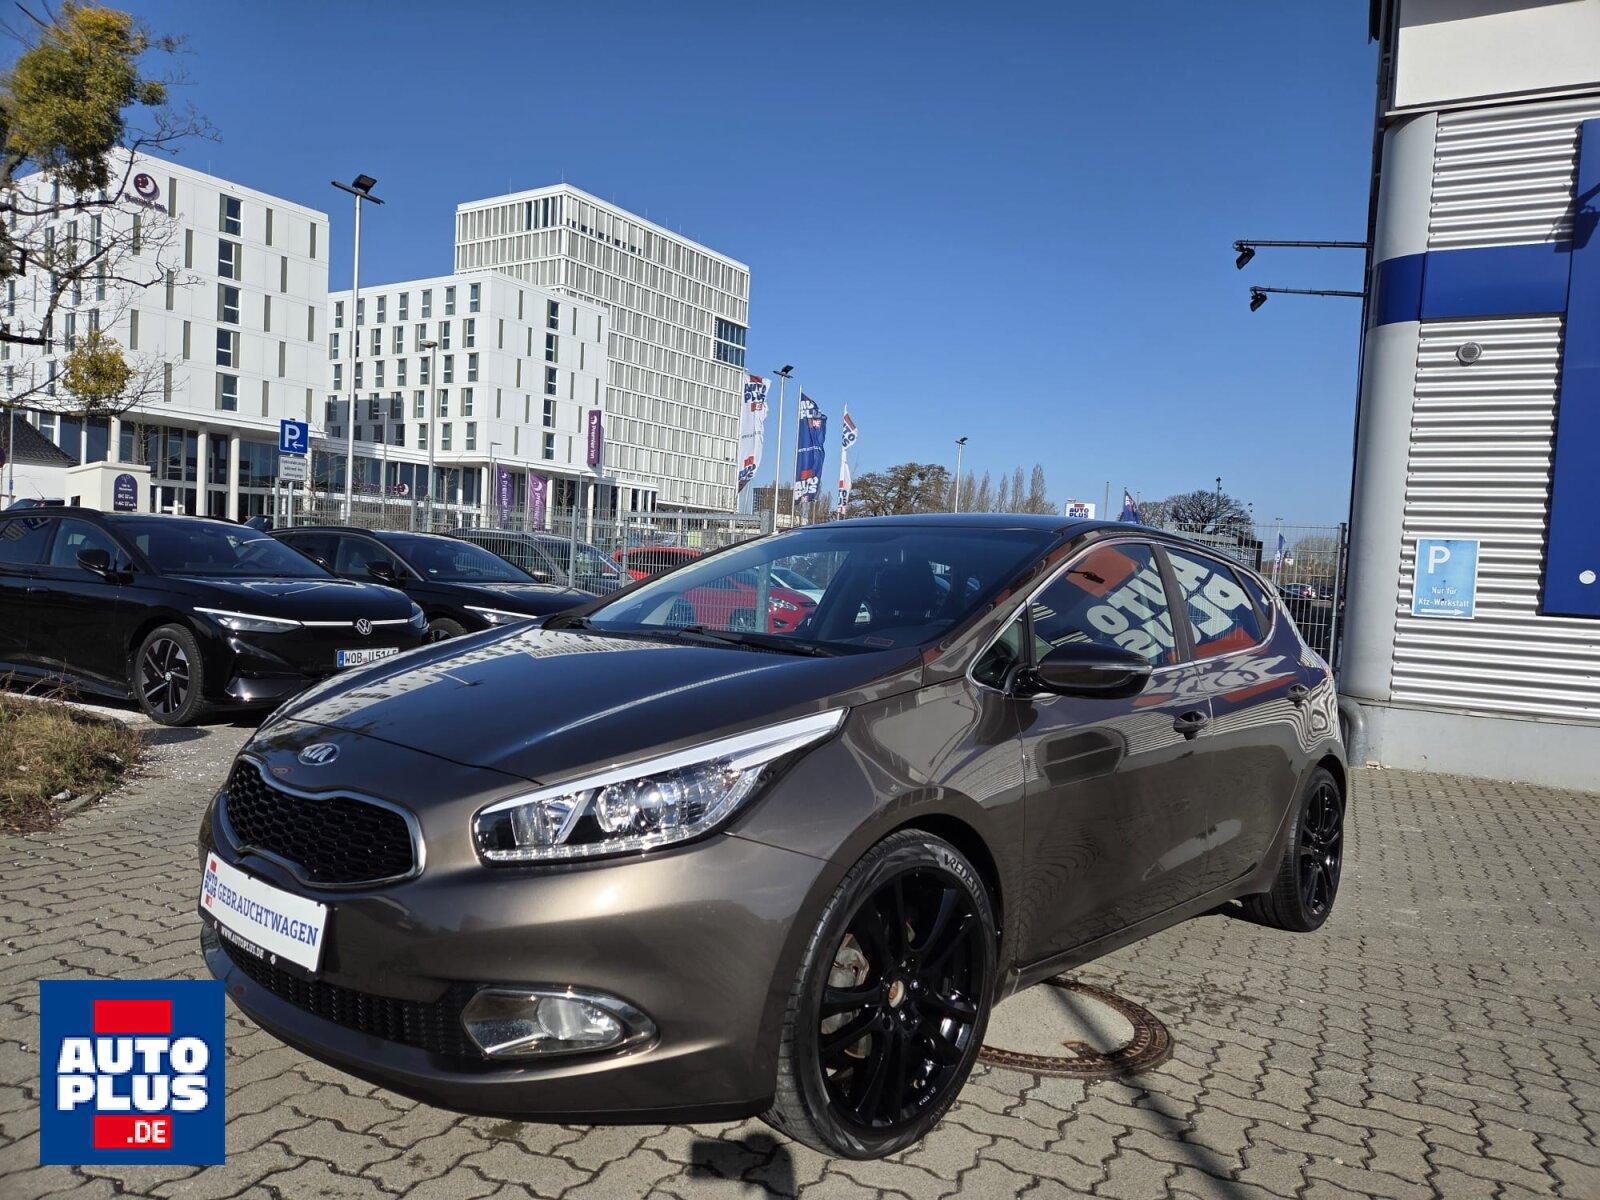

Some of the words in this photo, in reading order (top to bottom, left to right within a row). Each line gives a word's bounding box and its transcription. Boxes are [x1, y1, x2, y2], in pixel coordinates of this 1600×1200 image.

[744, 383, 767, 393] AUTO
[744, 391, 766, 403] PLUS
[284, 424, 300, 448] P
[1428, 545, 1451, 574] P
[345, 652, 363, 664] WOB
[217, 883, 319, 947] GEBRAUCHTWAGEN
